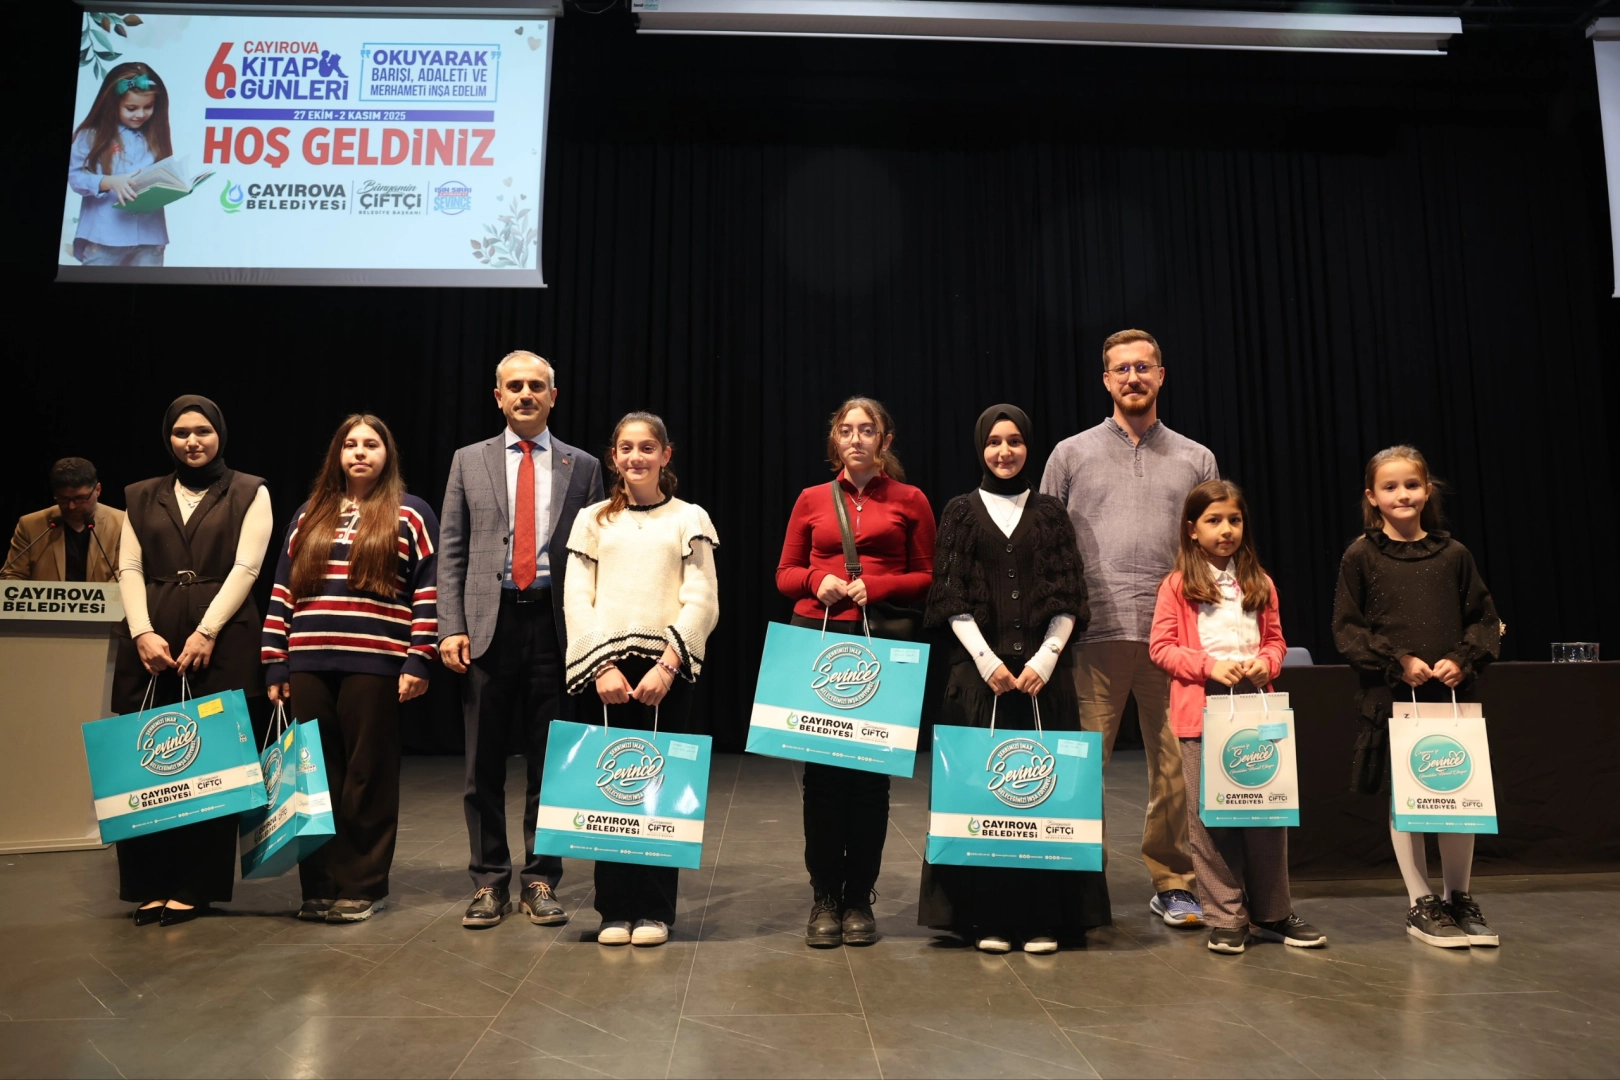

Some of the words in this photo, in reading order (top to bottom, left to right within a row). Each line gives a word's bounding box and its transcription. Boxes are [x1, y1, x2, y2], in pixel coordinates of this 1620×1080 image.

[243, 41, 319, 54] ÇAYIROVA
[204, 42, 237, 99] 6.
[241, 56, 318, 78] KİTAP
[371, 68, 414, 83] BARIŞI,
[418, 68, 468, 82] ADALETİ
[473, 69, 488, 82] VE
[240, 79, 349, 100] GÜNLERİ
[370, 85, 426, 96] MERHAMETİ
[293, 110, 306, 120] 27
[308, 109, 334, 120] EKİM
[339, 111, 346, 120] 2
[347, 111, 381, 120] KASIM
[383, 111, 406, 120] 2025
[203, 126, 291, 169] HOŞ
[302, 127, 496, 166] GELDİNİZ
[247, 183, 347, 198] ÇAYIROVA
[359, 193, 422, 210] ÇİFTÇİ
[4, 587, 105, 601] ÇAYIROVA
[811, 660, 881, 691] Sevince
[140, 721, 198, 767] Sevince
[1229, 744, 1274, 768] Sevince
[1418, 750, 1466, 773] Sevince
[596, 755, 665, 787] Sevince
[987, 755, 1056, 791] Sevince
